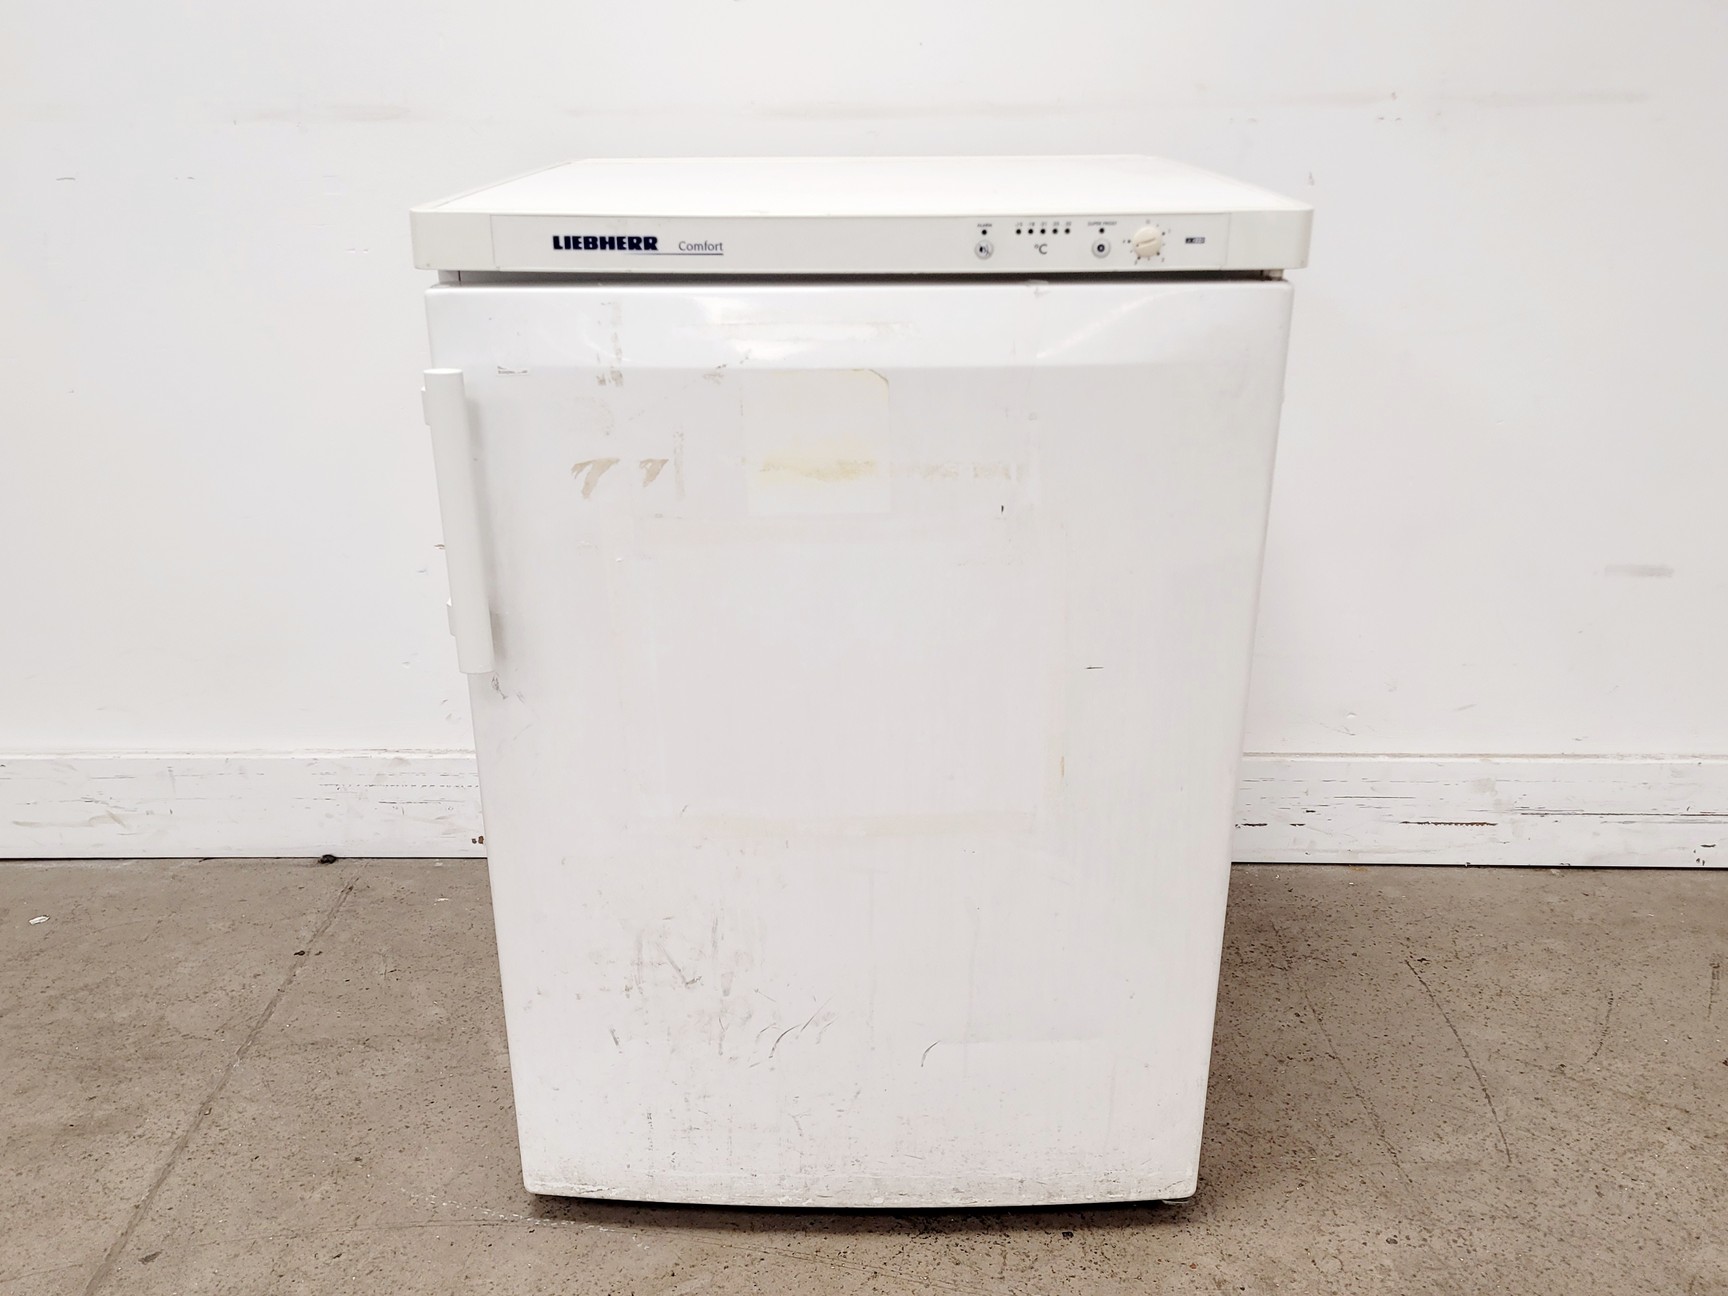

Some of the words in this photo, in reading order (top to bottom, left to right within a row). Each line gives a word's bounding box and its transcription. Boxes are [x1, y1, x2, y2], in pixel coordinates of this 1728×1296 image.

[552, 235, 659, 251] LIEBHERR
[678, 239, 723, 251] Comfort
[1034, 243, 1048, 255] °C
